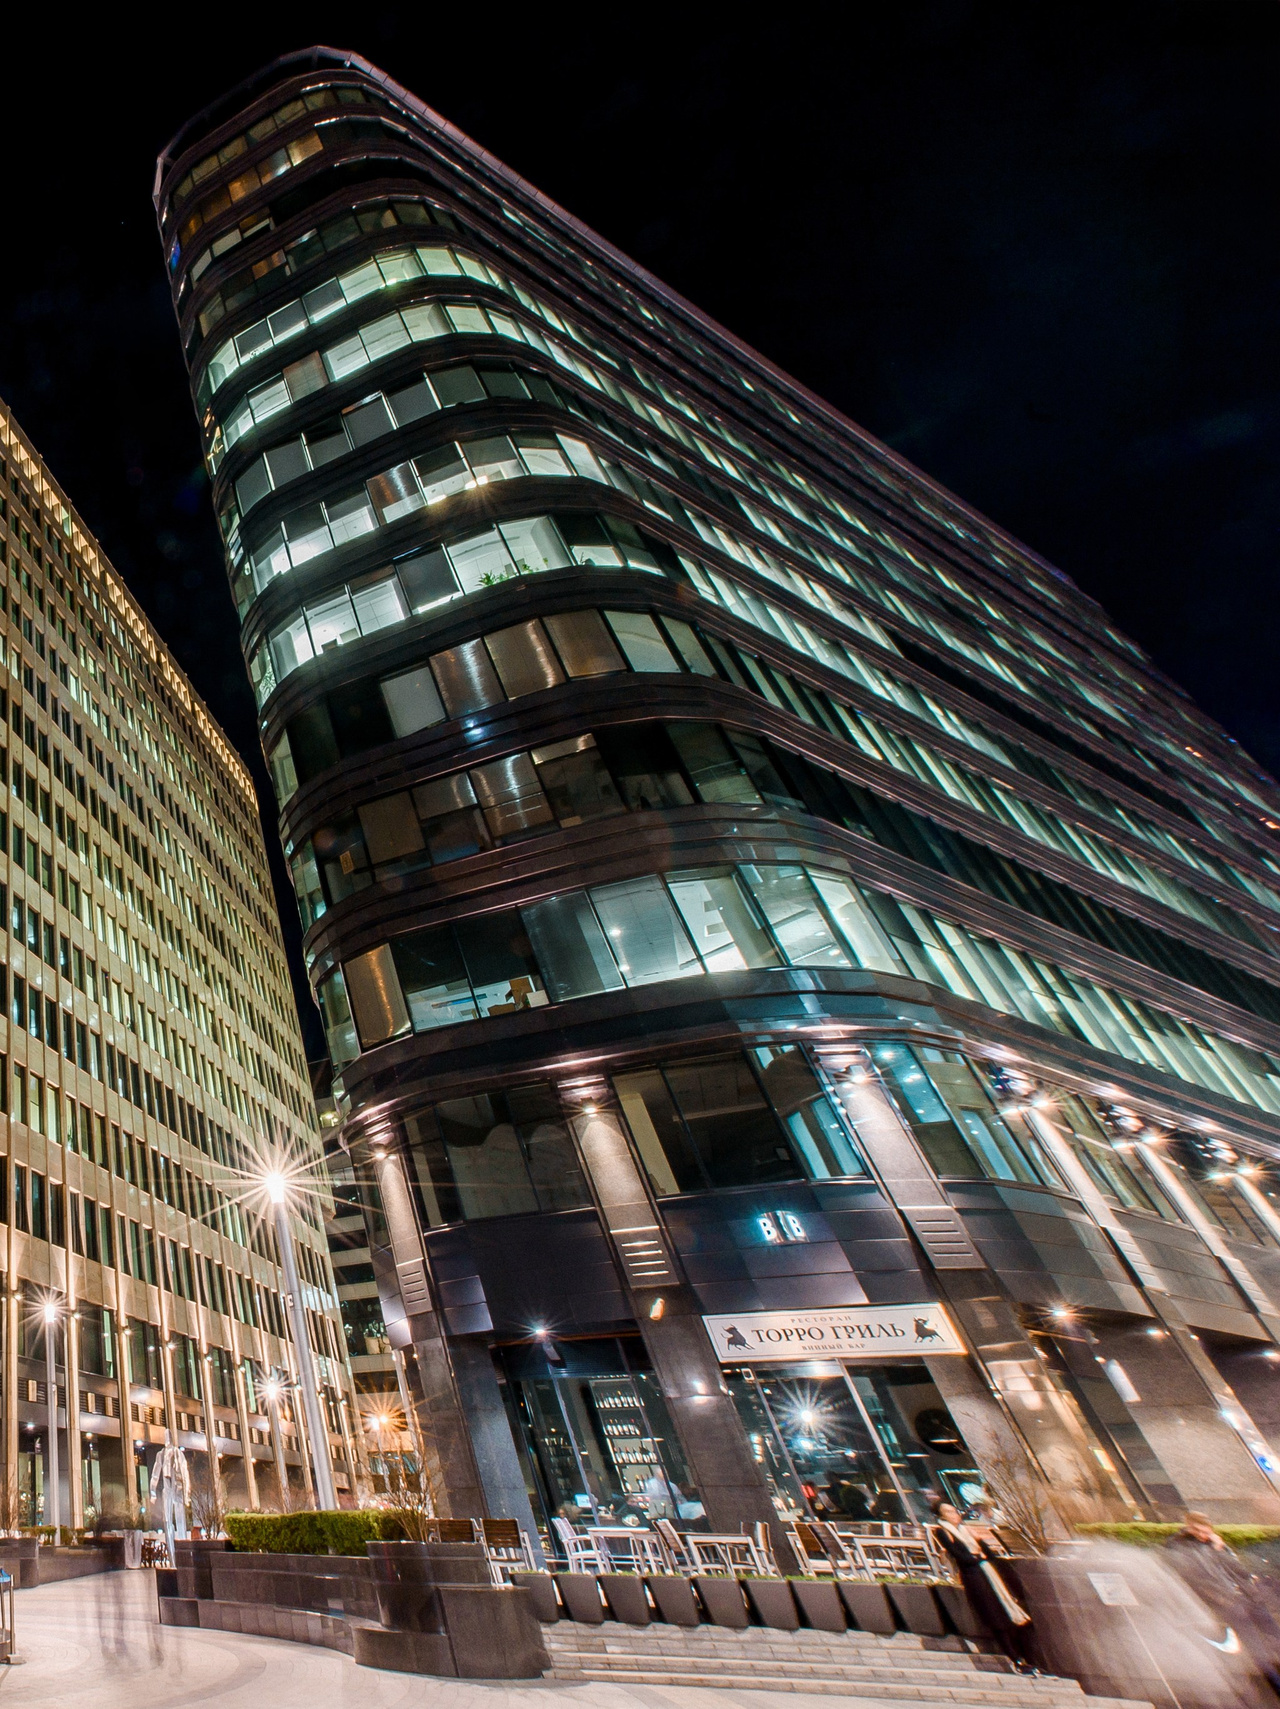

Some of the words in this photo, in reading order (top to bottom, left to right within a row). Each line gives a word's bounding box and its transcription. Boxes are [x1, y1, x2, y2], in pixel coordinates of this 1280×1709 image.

[790, 1315, 852, 1323] РЕСТОРАН
[751, 1326, 825, 1343] ТОРРО
[829, 1323, 905, 1340] ГРИЛЬ
